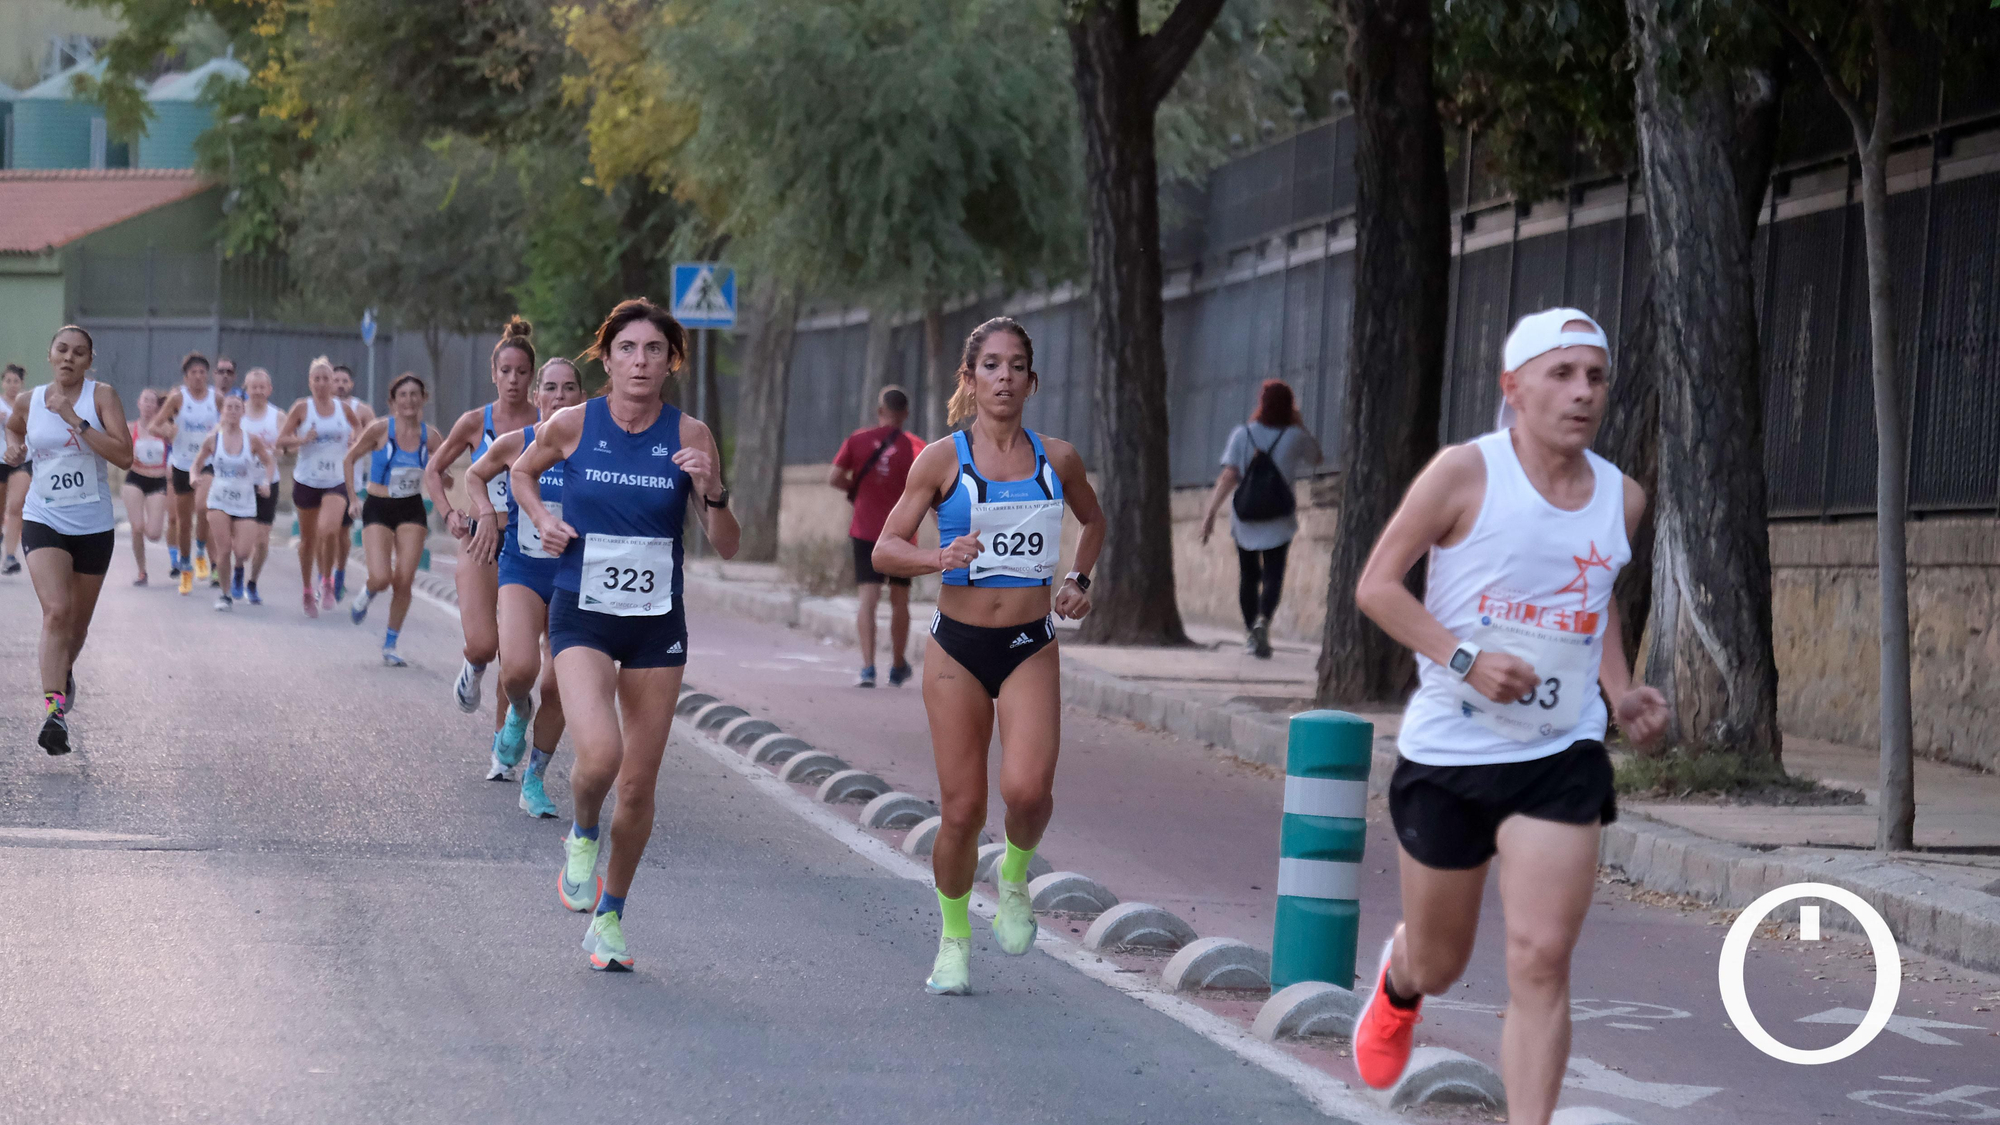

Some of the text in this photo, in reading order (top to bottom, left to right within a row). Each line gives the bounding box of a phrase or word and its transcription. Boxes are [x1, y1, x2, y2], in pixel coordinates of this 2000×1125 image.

[50, 471, 85, 491] 260
[585, 468, 675, 490] TROTASIERRA
[988, 503, 1015, 512] CARRERA
[992, 532, 1044, 557] 629
[602, 566, 655, 594] 323
